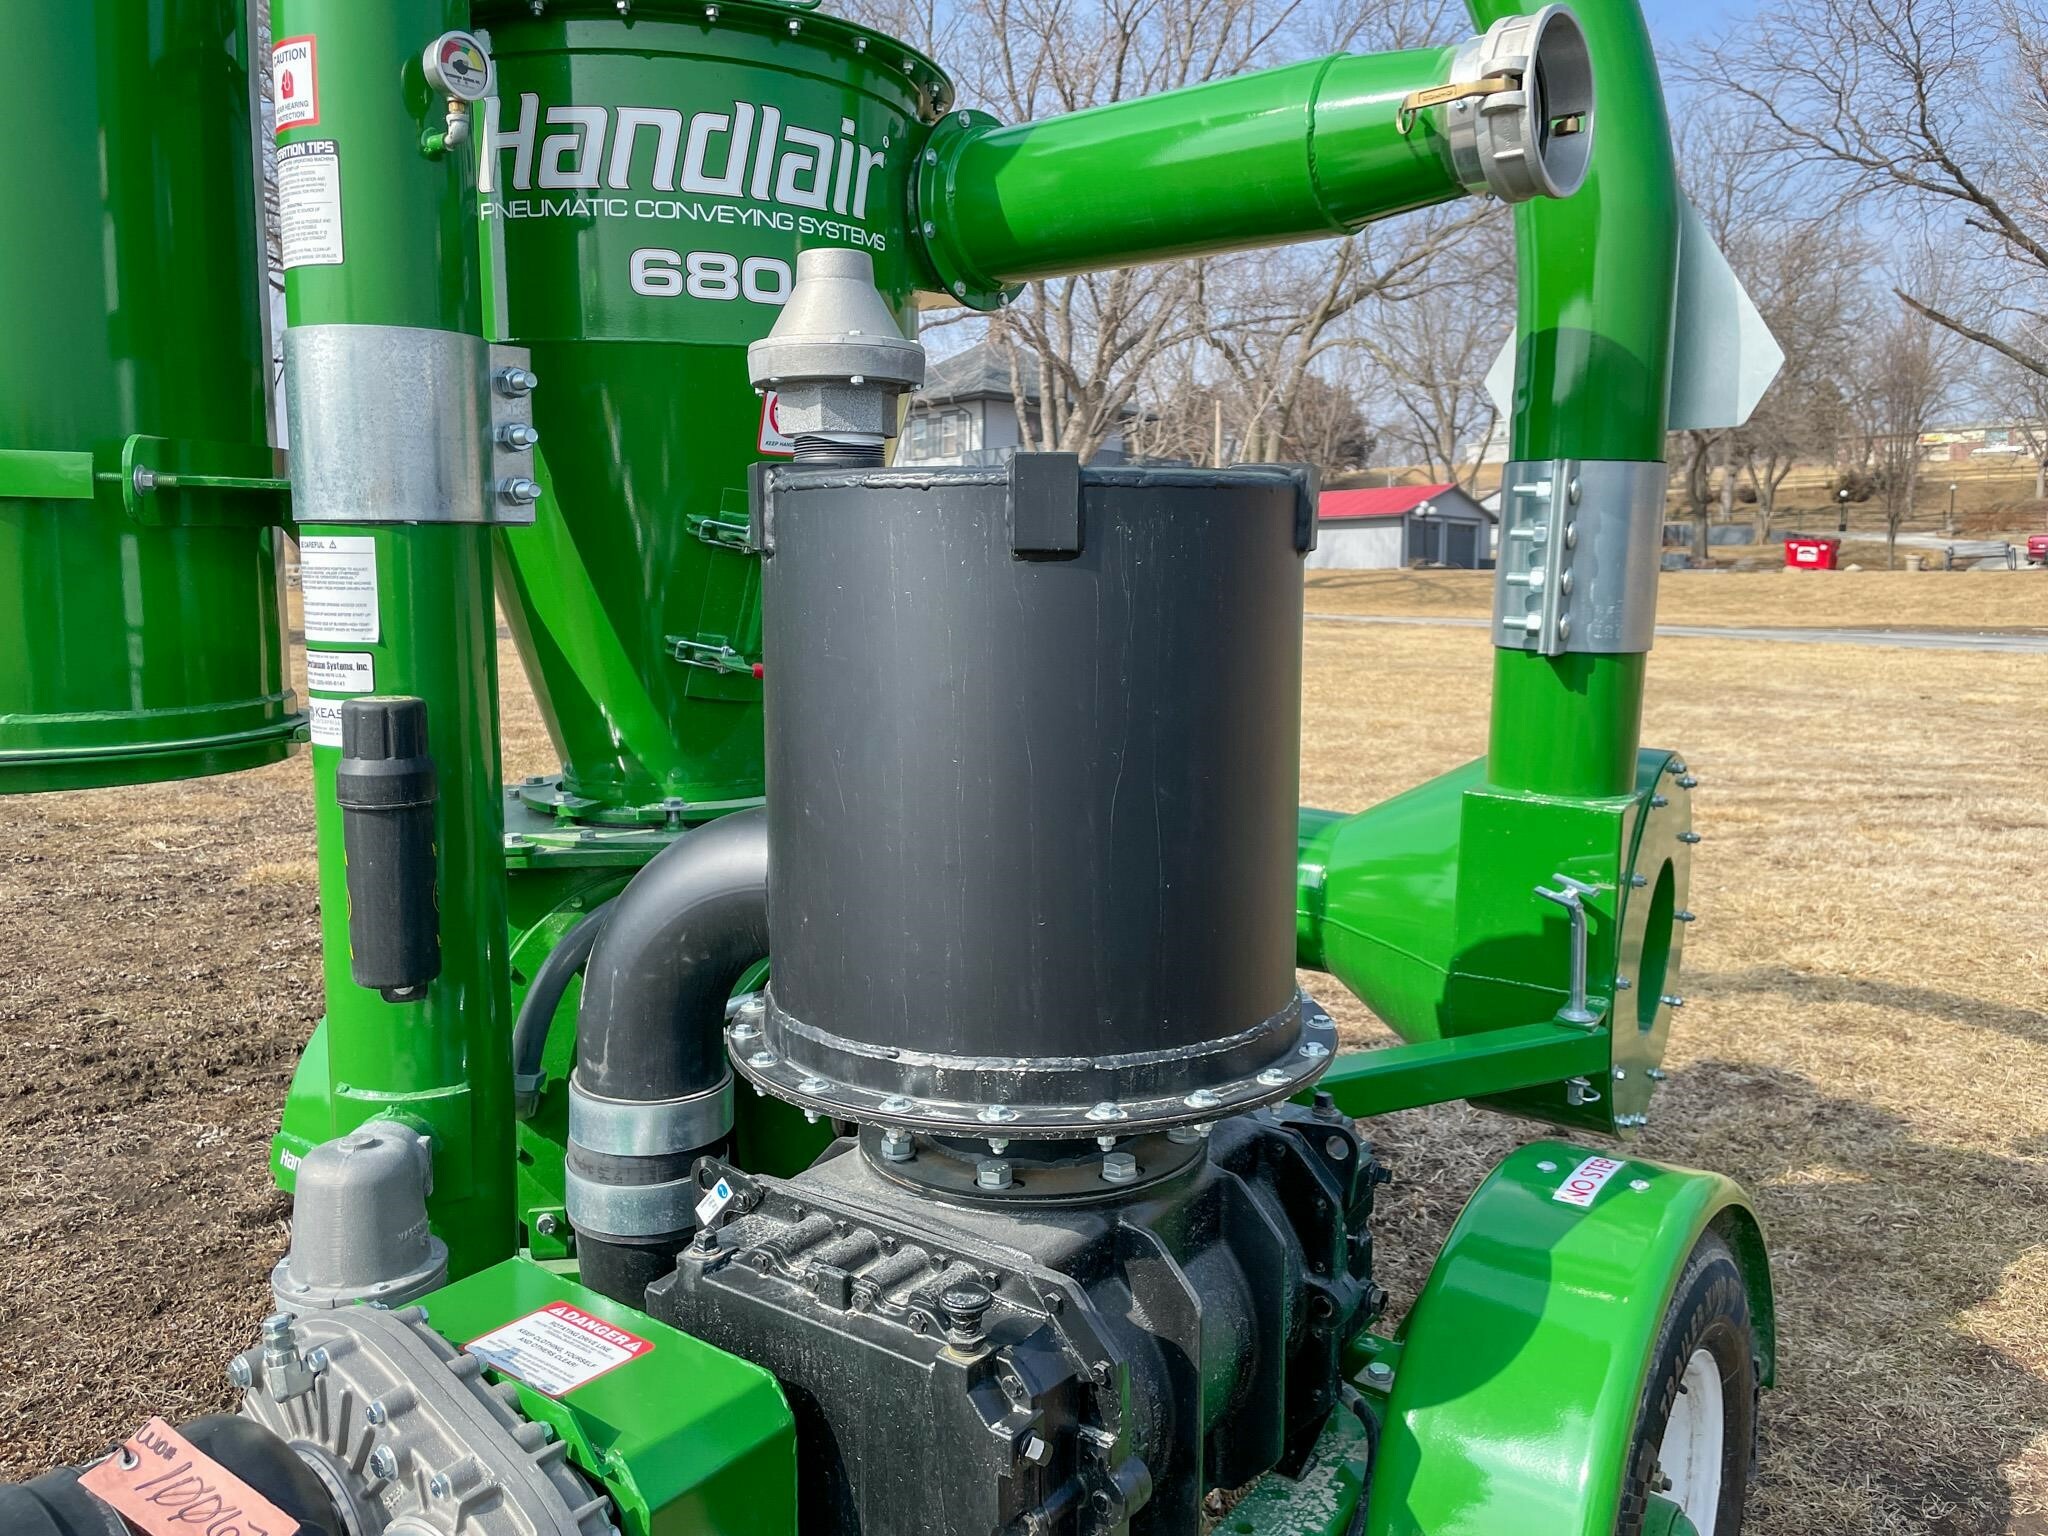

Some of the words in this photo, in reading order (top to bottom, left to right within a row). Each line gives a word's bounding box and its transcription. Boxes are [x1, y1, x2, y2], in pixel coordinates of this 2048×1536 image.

[274, 47, 307, 67] CAUTION
[307, 141, 334, 154] TIPS
[478, 93, 886, 220] Handlair
[480, 198, 629, 221] PNEUMATIC
[634, 200, 794, 232] CONVEYING
[798, 216, 886, 251] SYSTEMS
[629, 248, 793, 305] 680
[356, 662, 370, 671] Inc.
[315, 707, 342, 719] KEAS
[1561, 1179, 1595, 1202] NO
[1580, 1158, 1616, 1179] STEP
[550, 1321, 579, 1339] ROTATING
[578, 1332, 599, 1348] DRIVE
[596, 1343, 612, 1353] LINE
[563, 1311, 627, 1345] DANGER
[518, 1328, 533, 1338] KEEP
[564, 1350, 598, 1368] YOURSELF
[519, 1337, 532, 1347] AND
[530, 1342, 555, 1358] OTHERS
